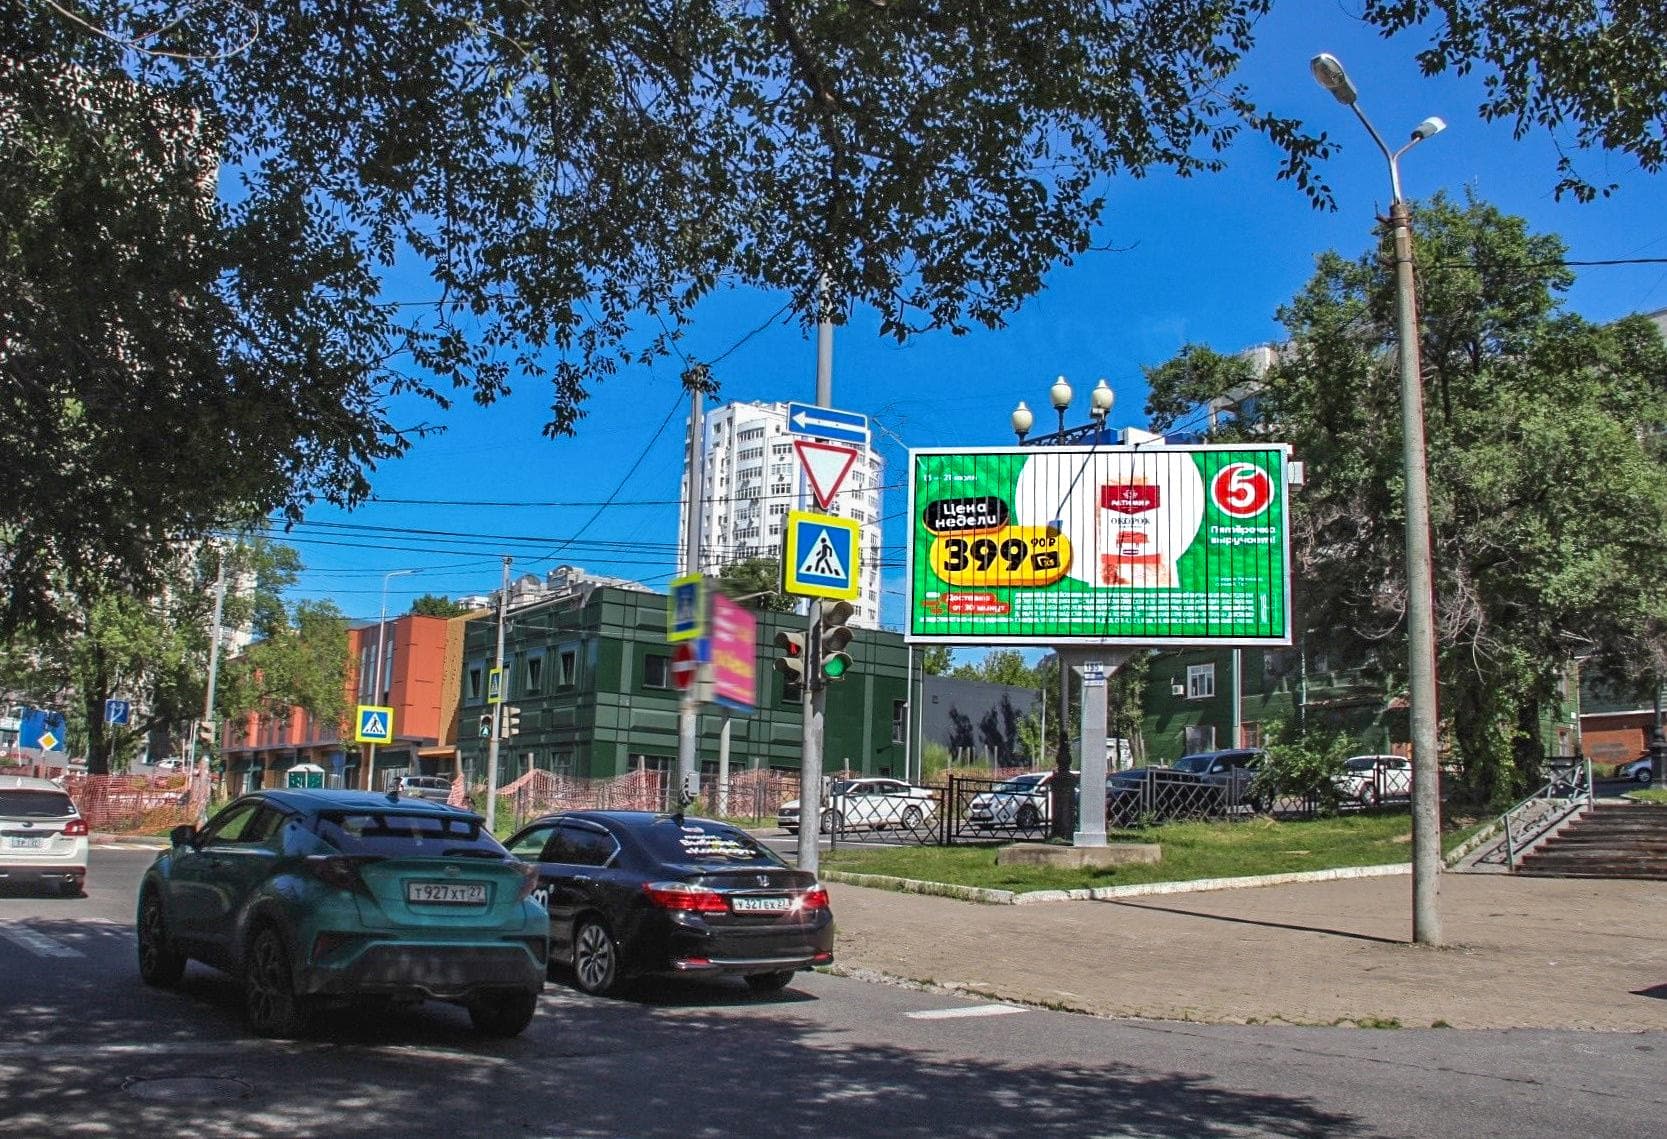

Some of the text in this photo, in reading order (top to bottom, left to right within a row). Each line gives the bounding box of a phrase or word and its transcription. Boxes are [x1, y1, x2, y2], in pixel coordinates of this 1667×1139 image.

[1228, 466, 1256, 508] 5
[943, 502, 988, 516] Цена
[935, 514, 997, 529] недели
[944, 538, 1029, 572] 399
